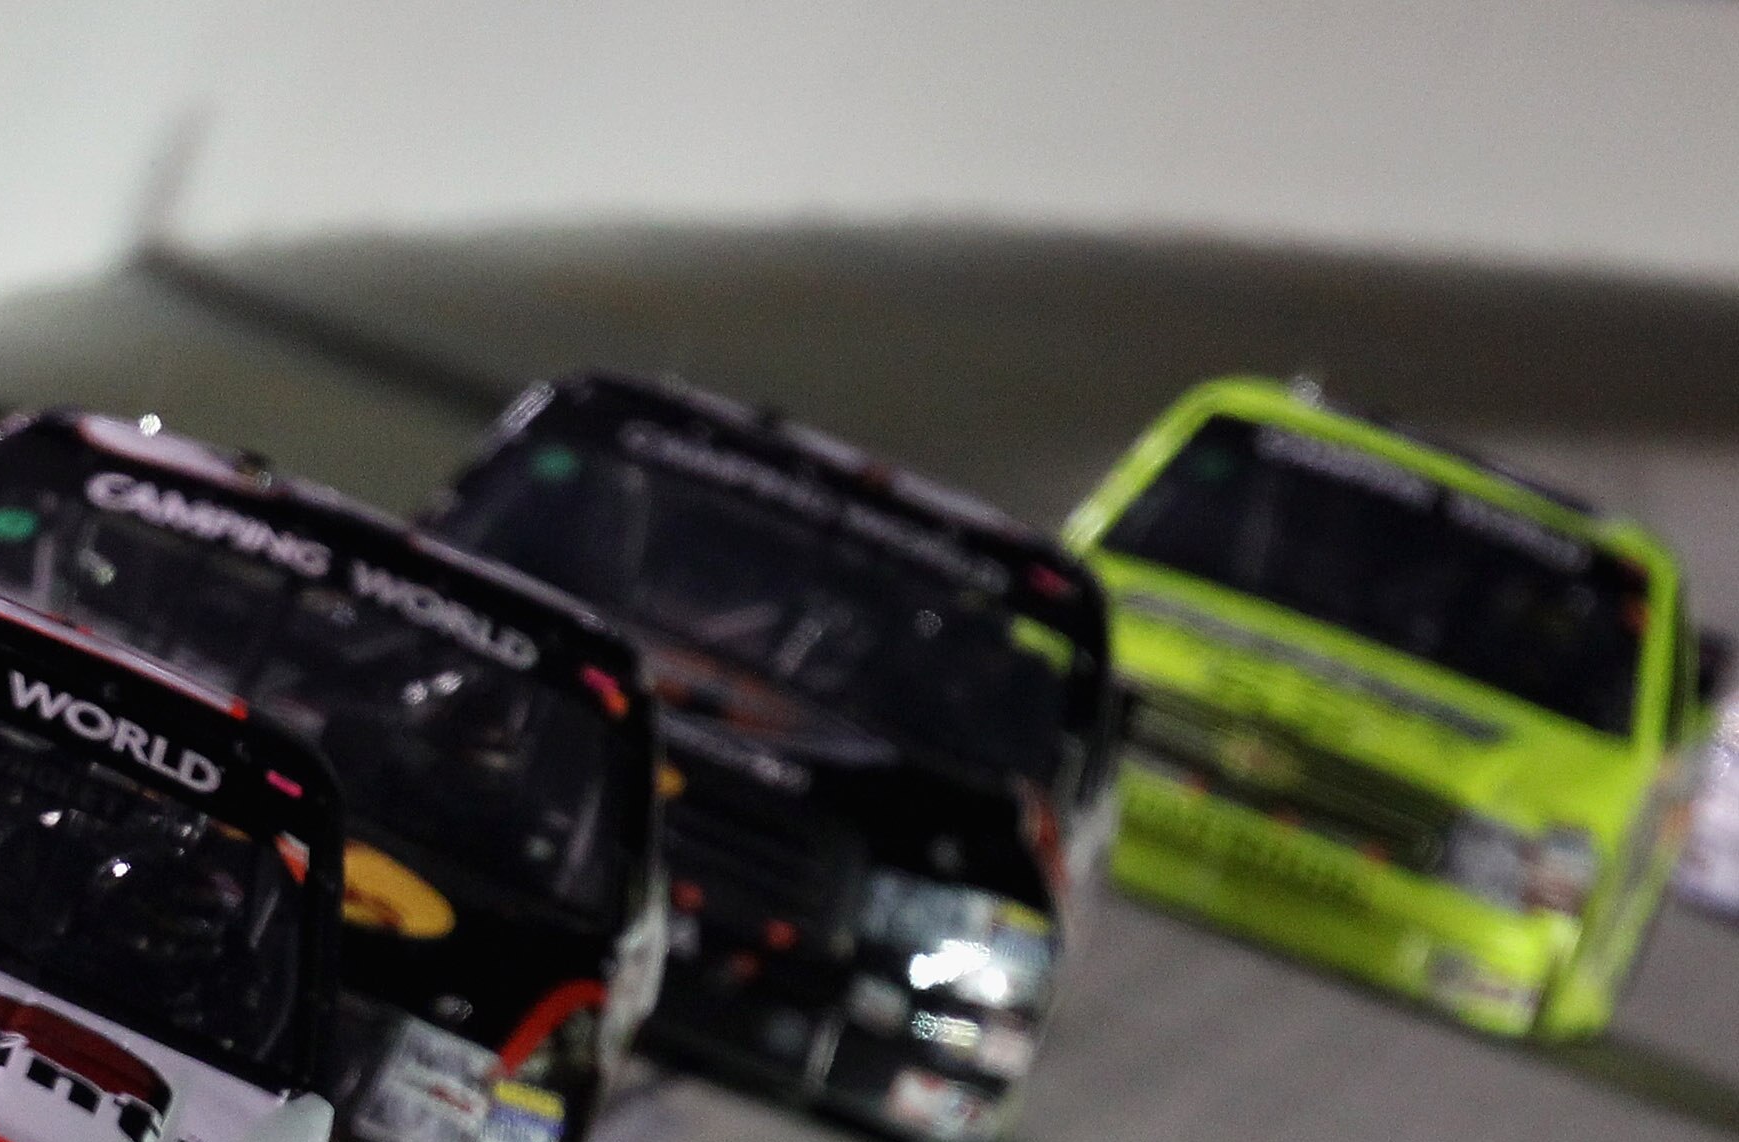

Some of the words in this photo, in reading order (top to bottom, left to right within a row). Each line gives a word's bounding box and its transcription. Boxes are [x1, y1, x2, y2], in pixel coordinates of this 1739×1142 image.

[84, 472, 332, 577] CAMPING
[349, 559, 539, 670] WORLD
[8, 671, 221, 793] WORLD
